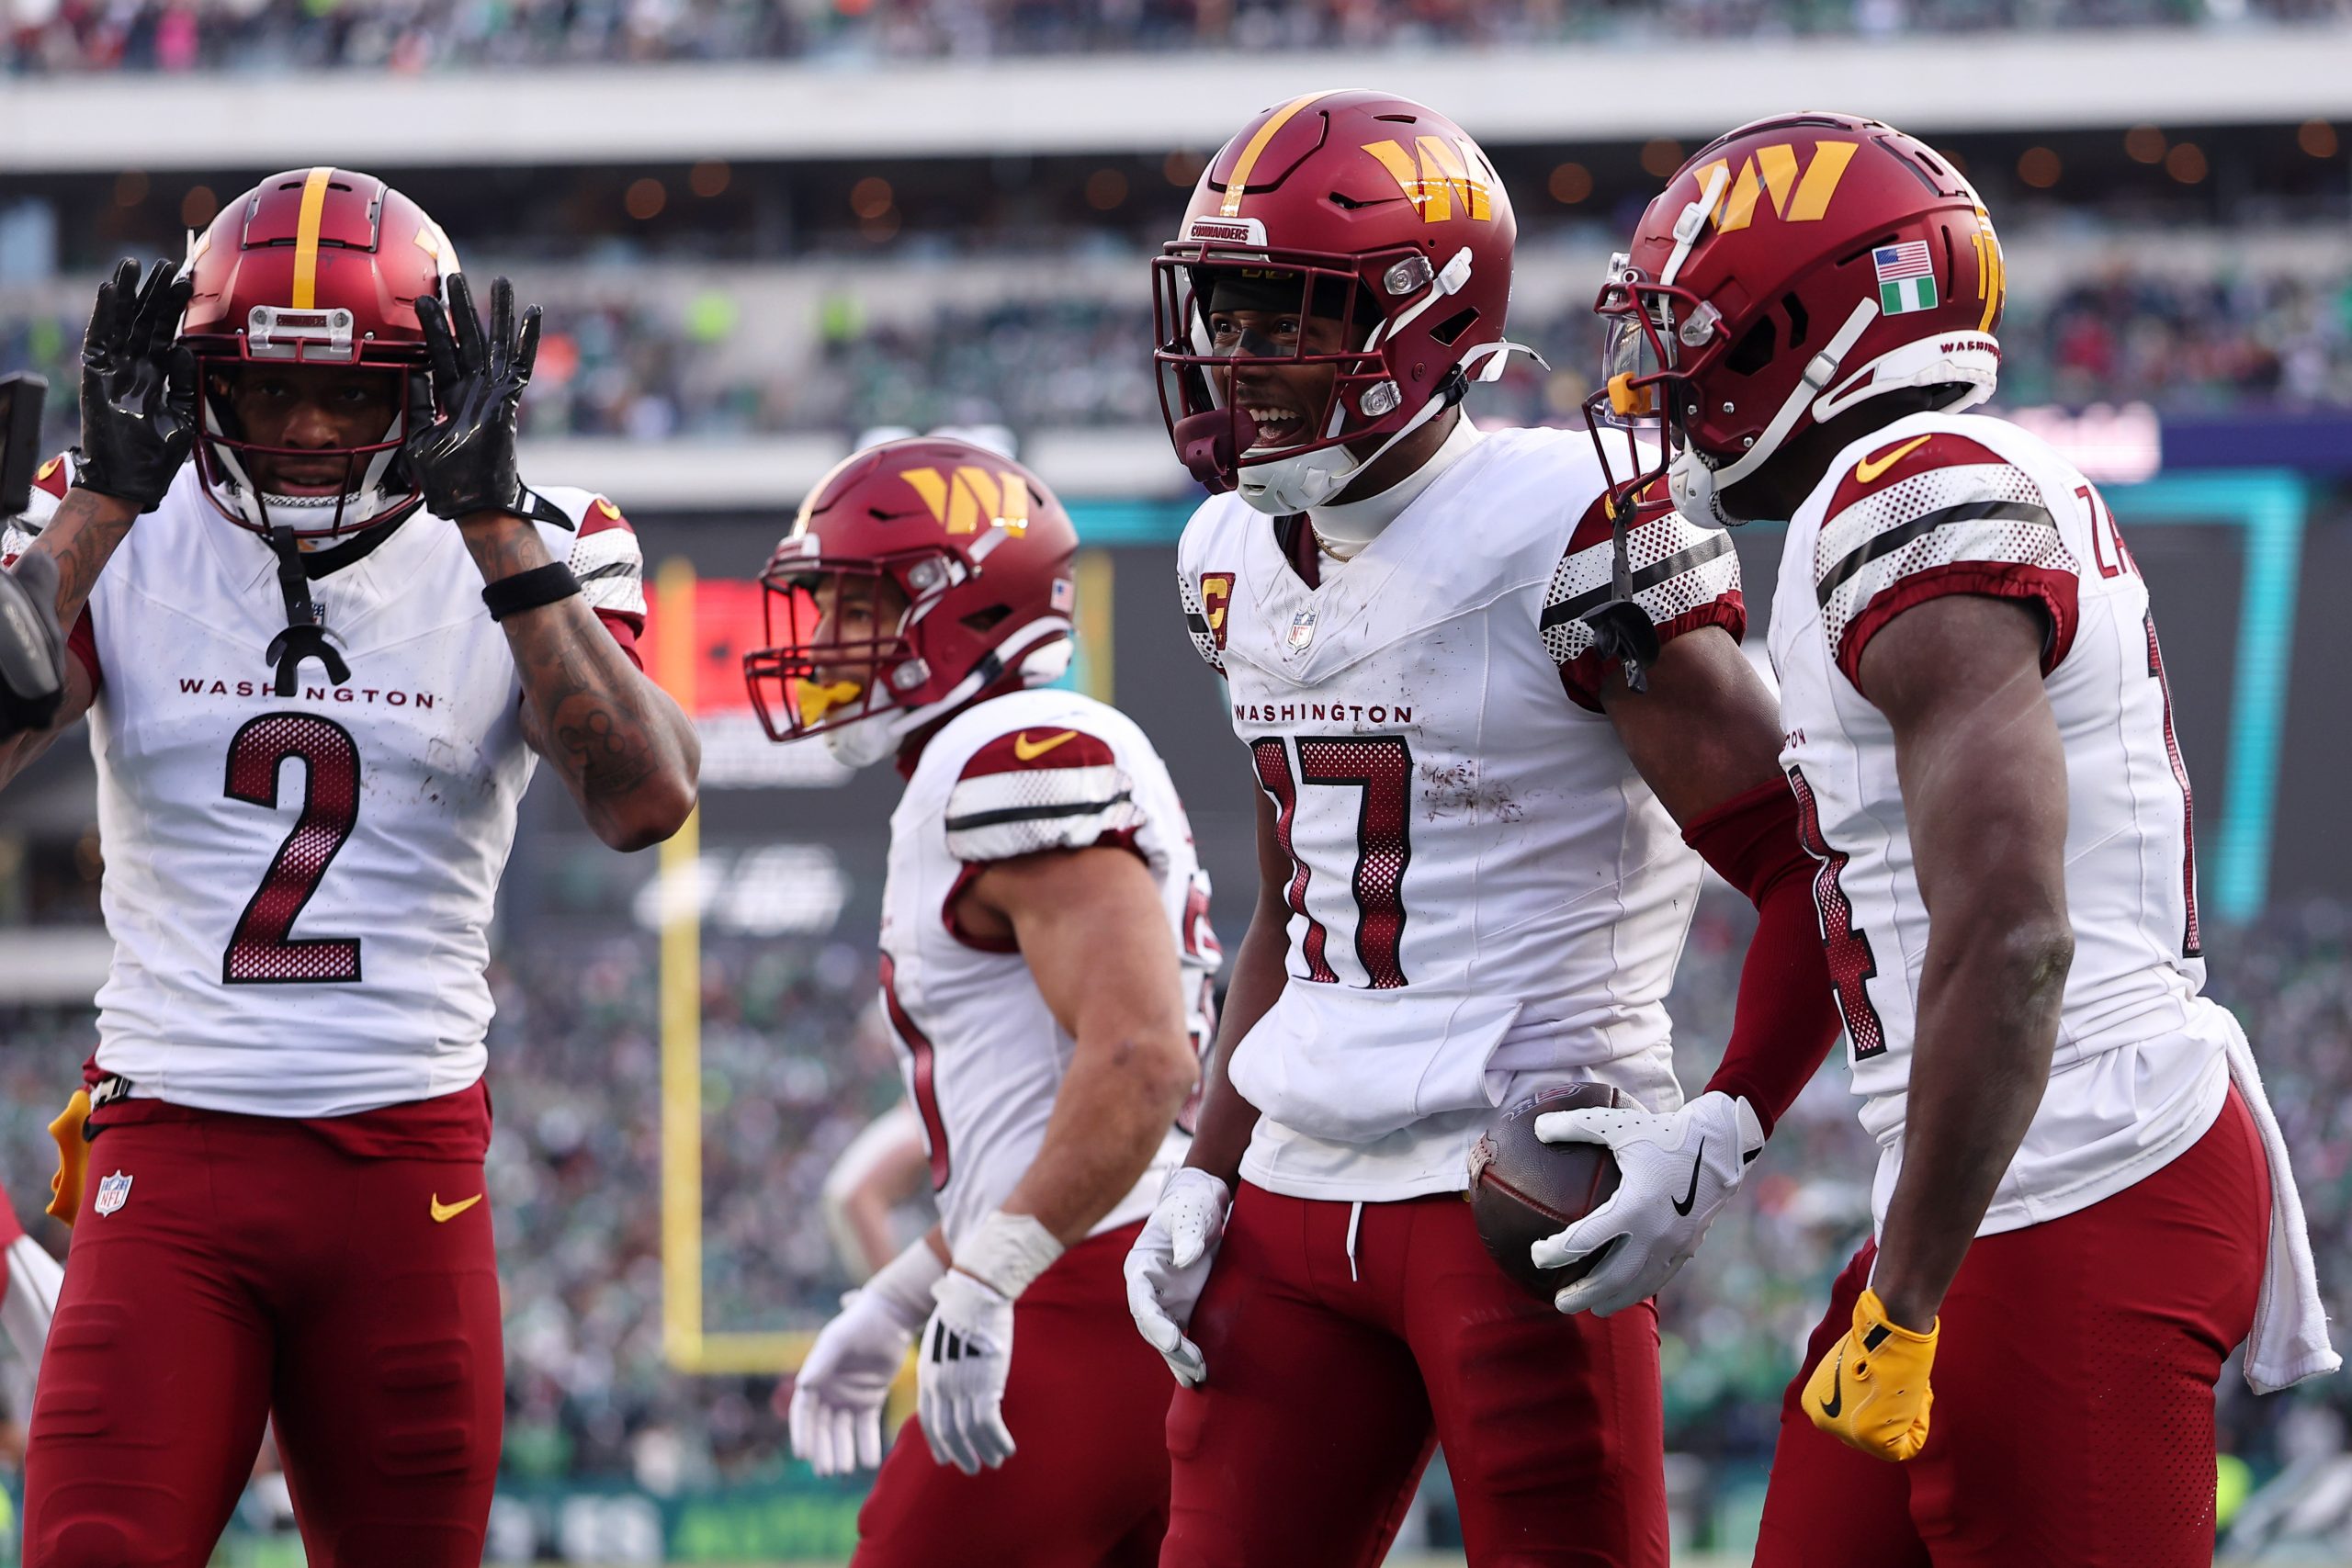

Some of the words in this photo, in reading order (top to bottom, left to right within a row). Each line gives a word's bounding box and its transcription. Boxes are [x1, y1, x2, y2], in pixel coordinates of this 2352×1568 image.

[1191, 225, 1249, 241] COMMANDERS
[1202, 578, 1228, 630] C
[179, 678, 434, 708] WASHNGTON
[1234, 704, 1412, 723] WASHINGTON
[223, 712, 362, 984] 2
[1250, 735, 1414, 990] 17
